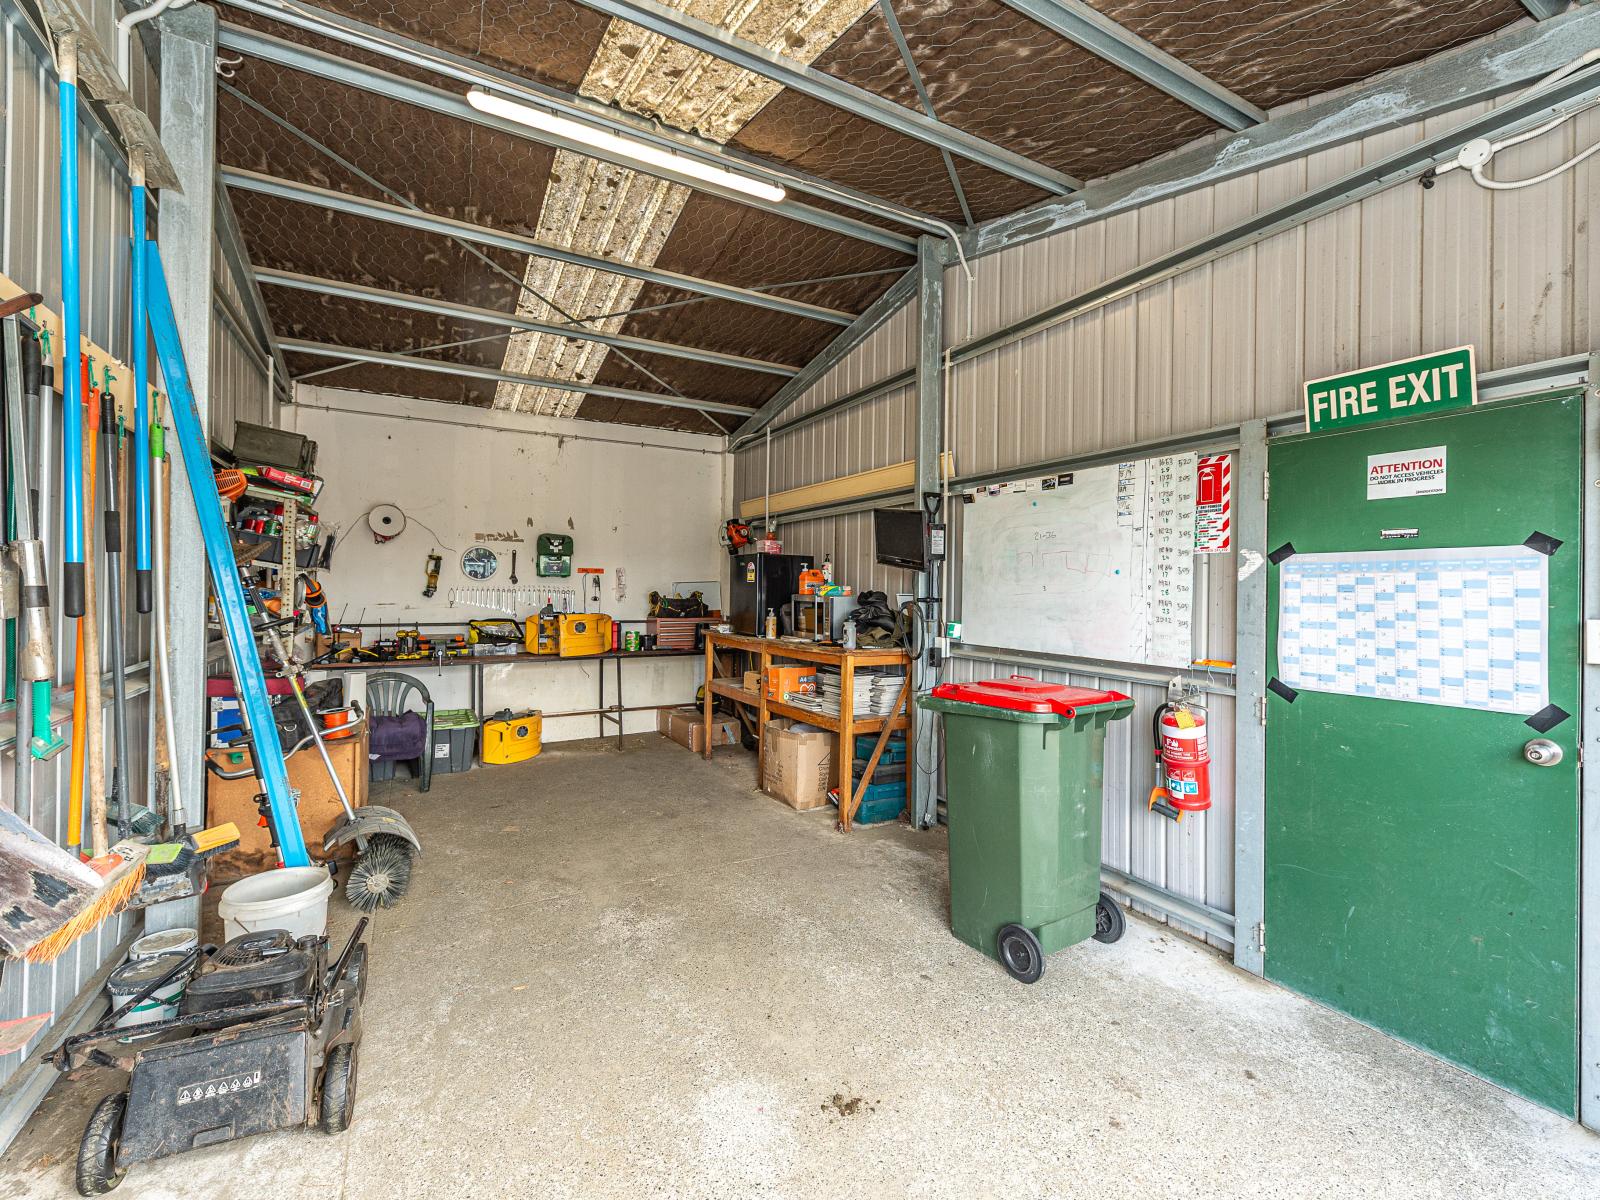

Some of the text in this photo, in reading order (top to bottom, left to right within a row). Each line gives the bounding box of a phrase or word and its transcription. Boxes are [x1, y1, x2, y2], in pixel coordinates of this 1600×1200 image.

[1312, 363, 1464, 422] FIRE EXIT
[1370, 458, 1443, 475] ATTENTION
[1415, 468, 1444, 477] VEHICLES
[1404, 474, 1436, 483] PROGRESS
